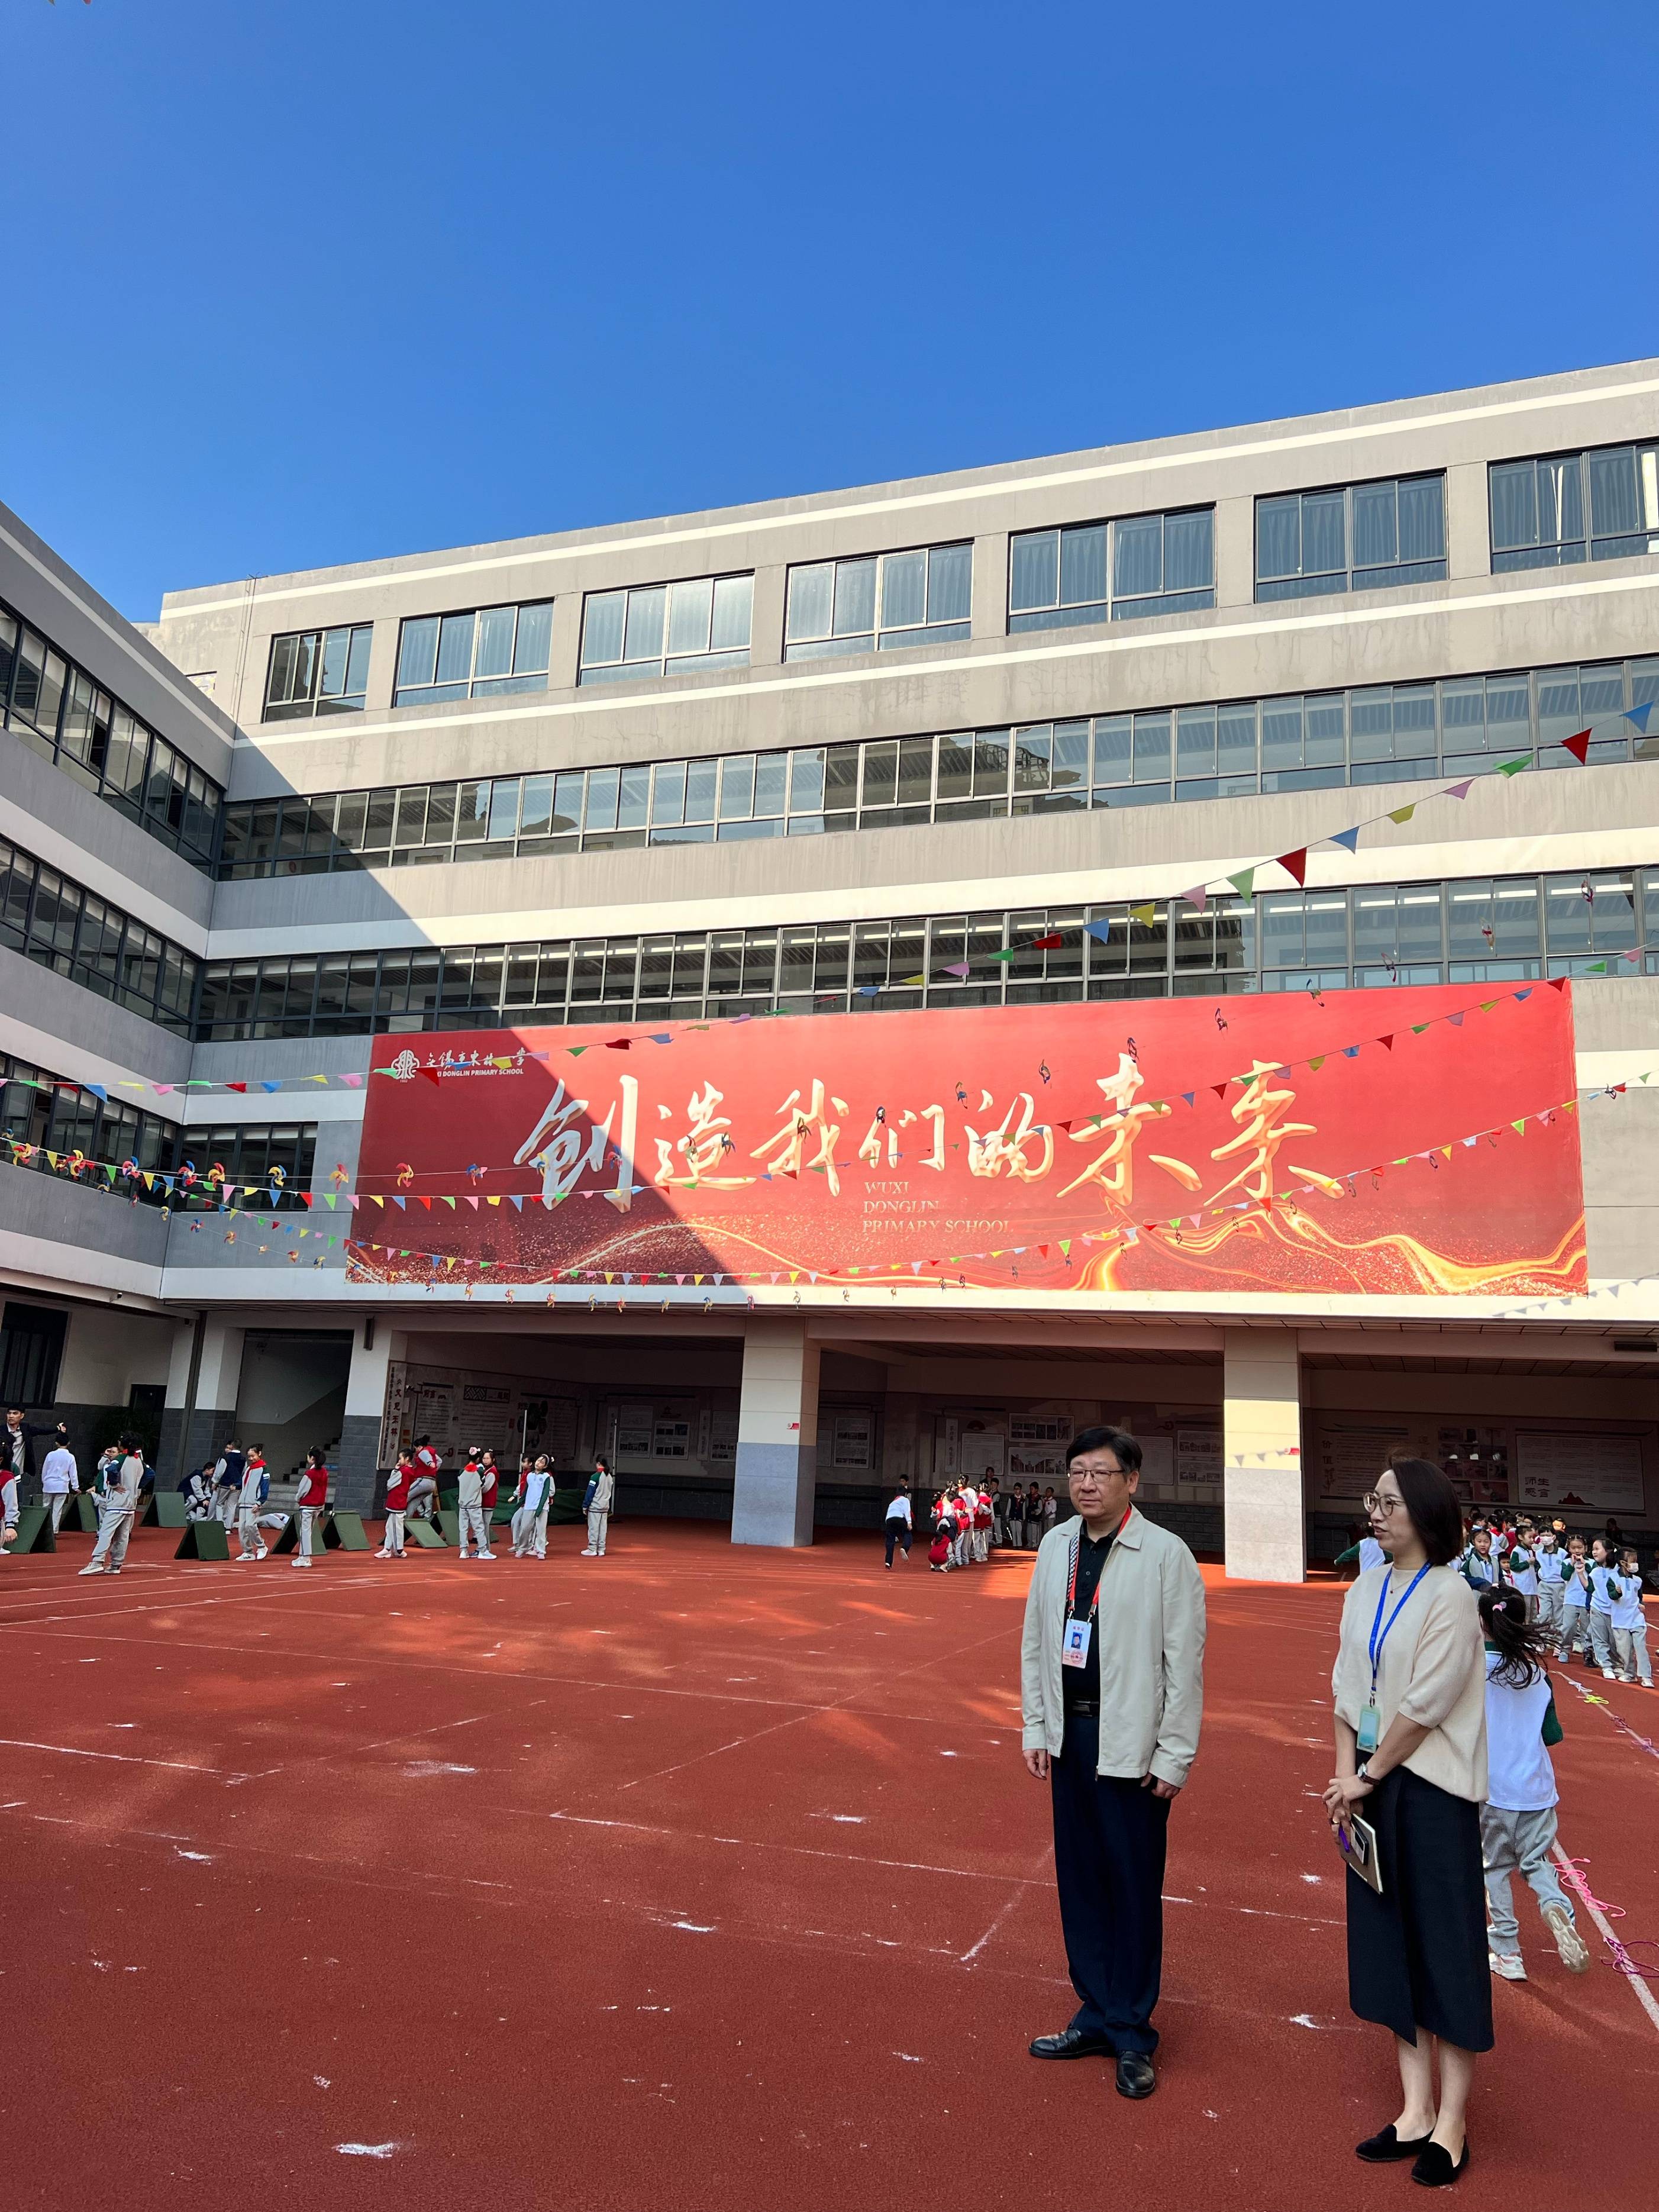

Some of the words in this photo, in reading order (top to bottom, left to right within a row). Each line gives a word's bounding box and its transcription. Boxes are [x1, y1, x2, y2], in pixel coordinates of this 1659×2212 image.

[864, 1181, 909, 1194] WUXI
[863, 1200, 940, 1213] DONGLIN
[862, 1220, 941, 1233] PRIMARY
